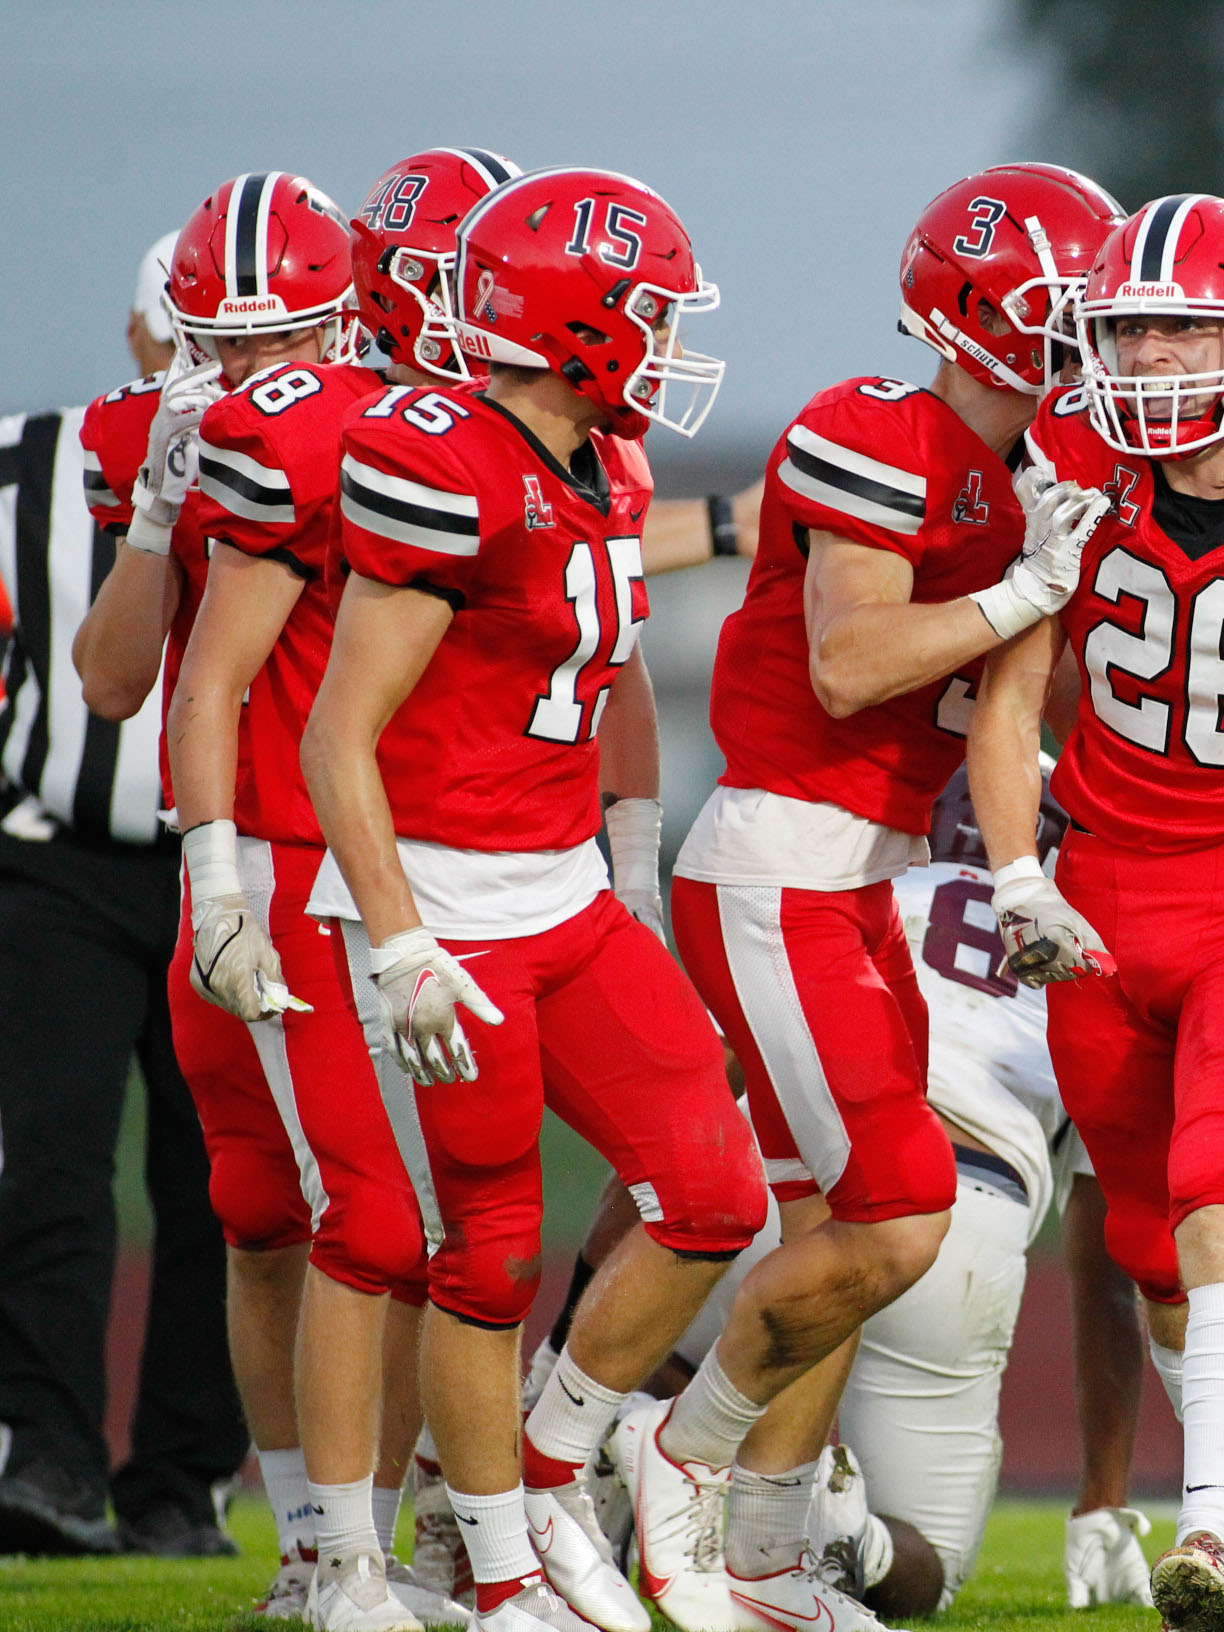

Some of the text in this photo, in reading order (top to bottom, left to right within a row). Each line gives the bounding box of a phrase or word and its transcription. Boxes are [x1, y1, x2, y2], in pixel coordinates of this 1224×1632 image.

[360, 173, 430, 232] 48
[953, 196, 1007, 260] 3
[565, 198, 647, 272] 15
[223, 299, 277, 314] Riddell
[1122, 285, 1175, 298] Riddell
[960, 339, 999, 370] schutt
[361, 384, 472, 436] 15
